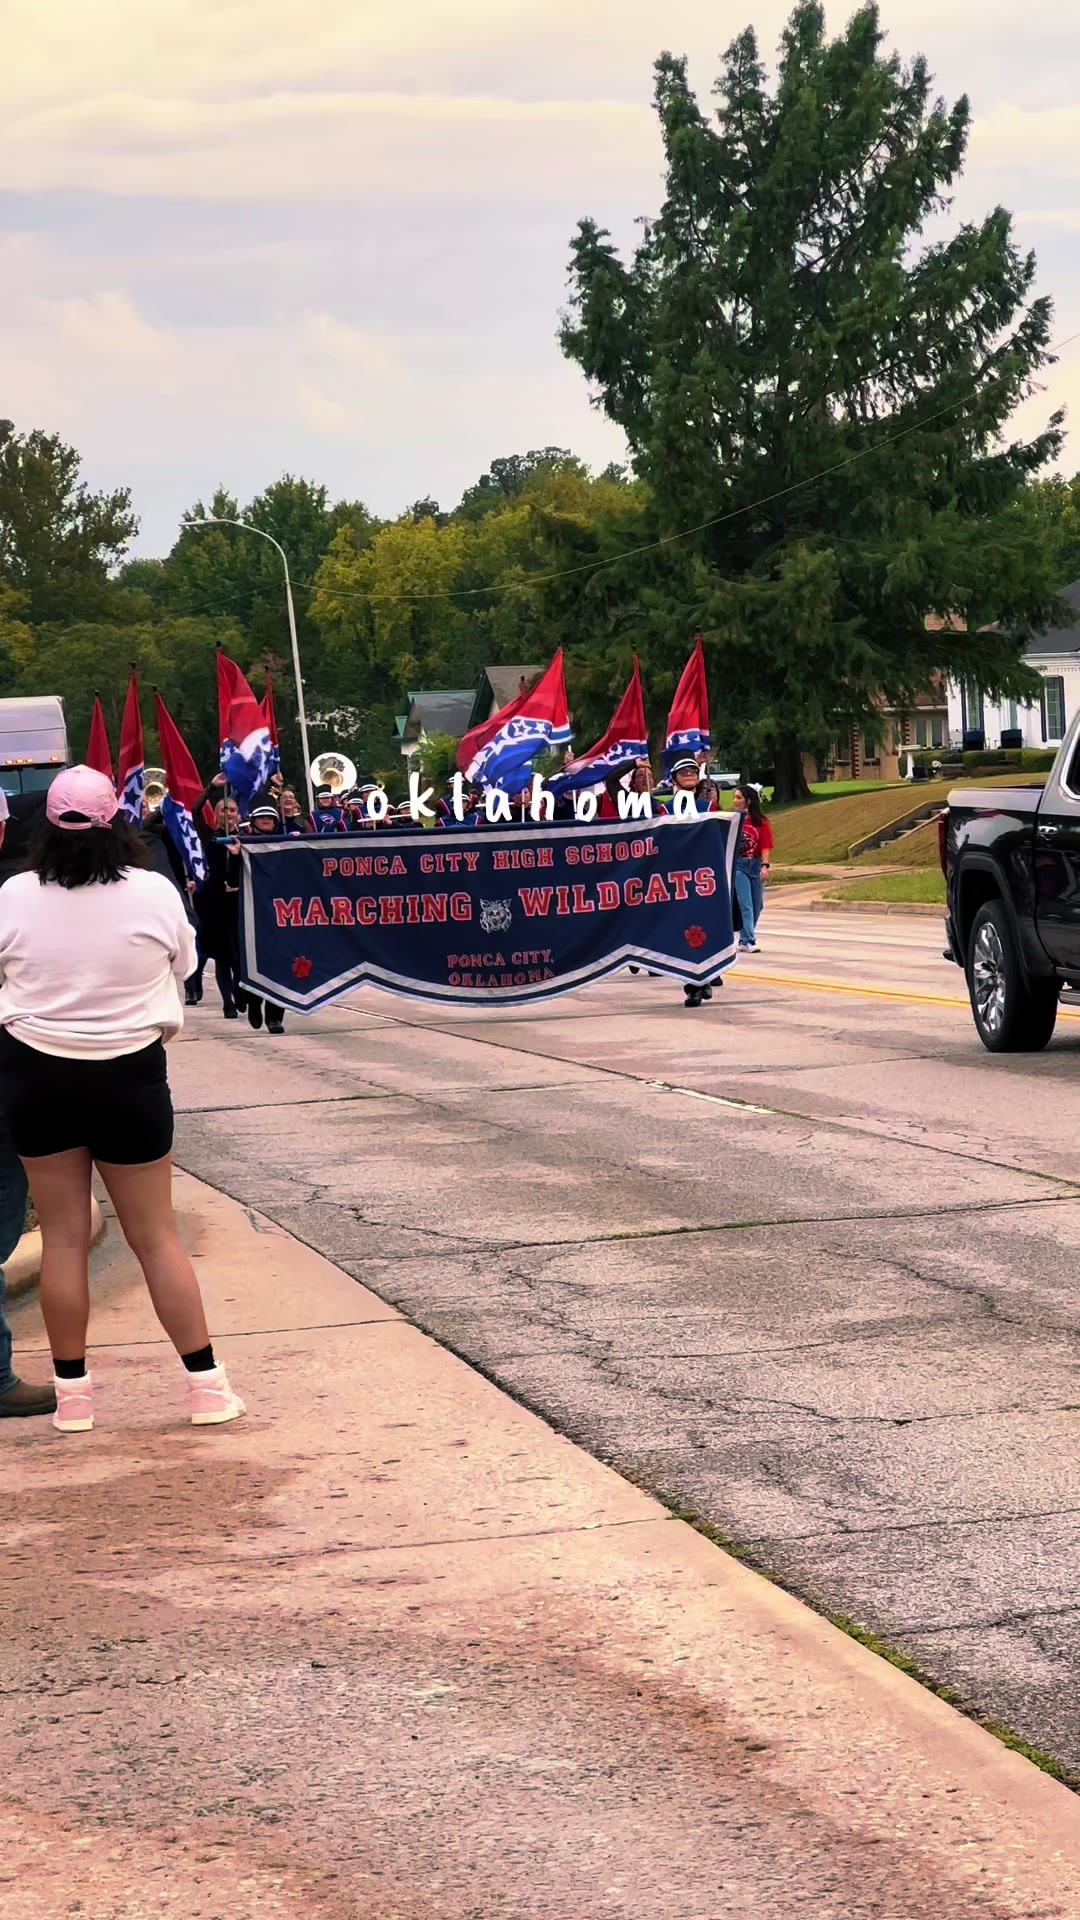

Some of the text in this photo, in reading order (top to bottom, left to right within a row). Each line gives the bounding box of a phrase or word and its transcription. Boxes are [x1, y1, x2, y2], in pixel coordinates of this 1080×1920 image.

[322, 836, 659, 877] PONCA CITY HIGH SCHOOL
[273, 867, 717, 928] MARCHING WILDCATS
[447, 952, 506, 968] PONCA
[448, 966, 555, 987] OKLAHOMA
